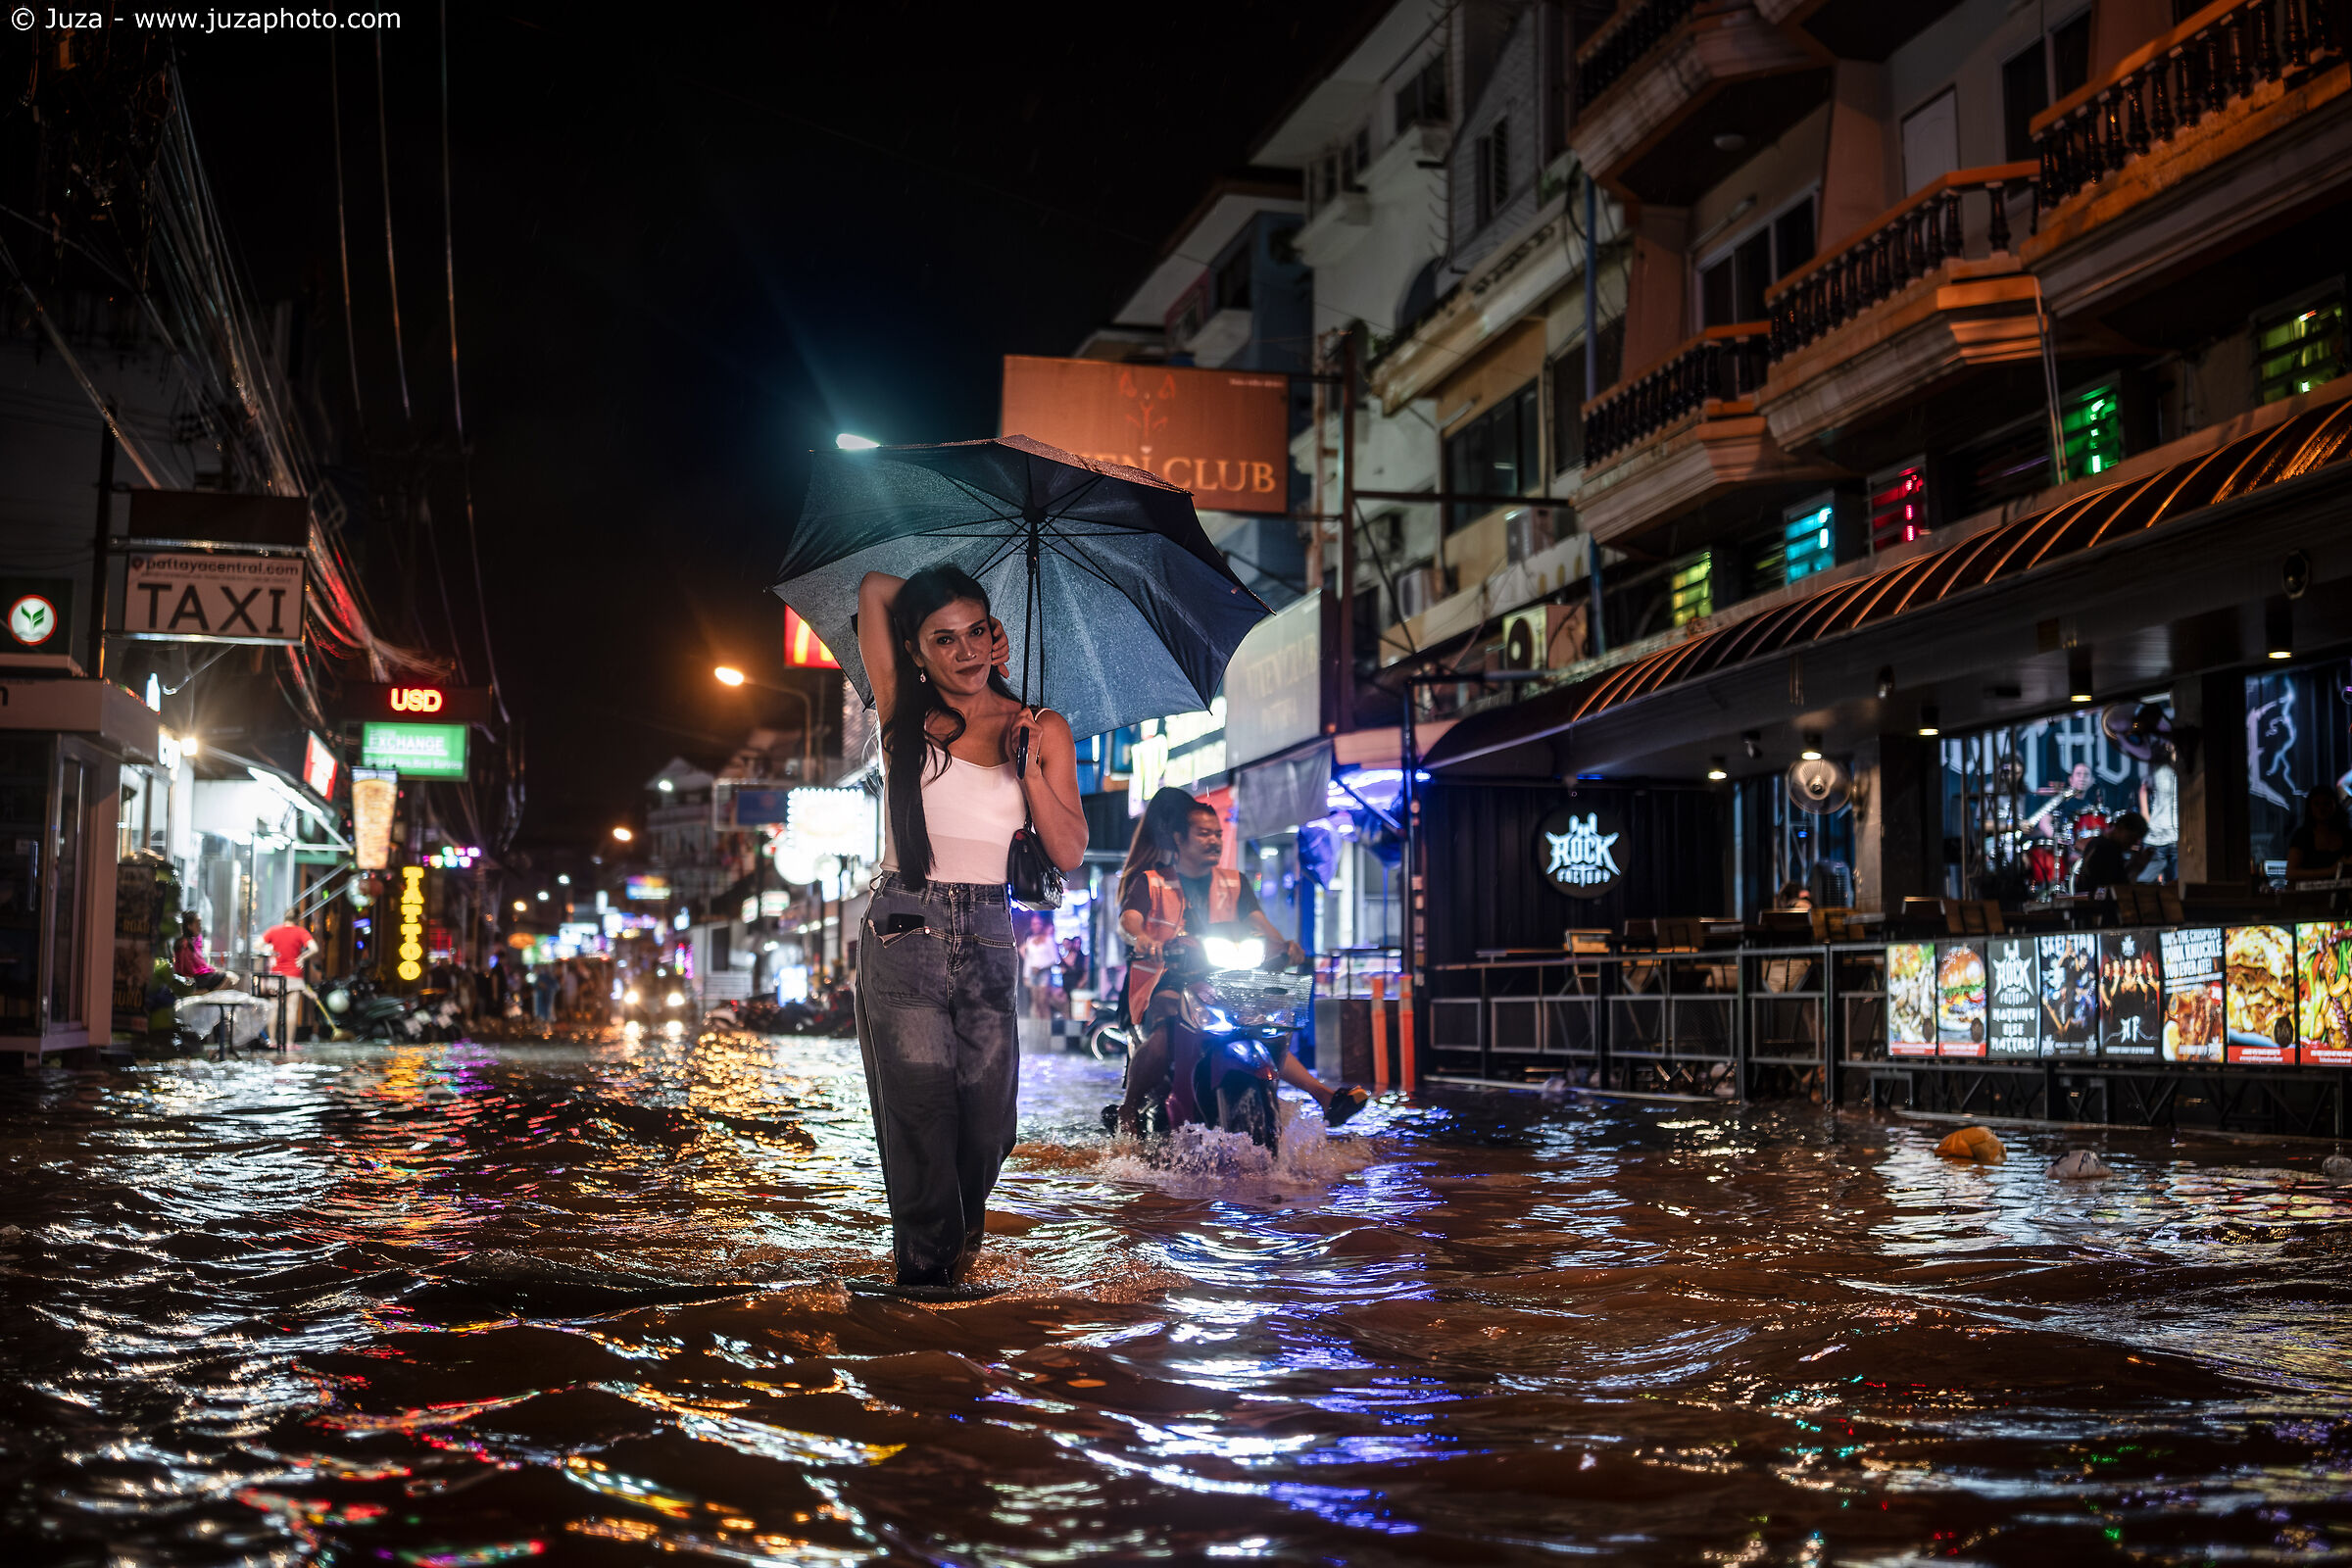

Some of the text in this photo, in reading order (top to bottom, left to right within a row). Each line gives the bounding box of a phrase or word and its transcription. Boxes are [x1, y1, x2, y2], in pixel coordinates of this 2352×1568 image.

[1163, 456, 1276, 494] CLUB
[146, 558, 299, 576] pattayacentral.com
[137, 582, 286, 634] TAXI
[390, 688, 443, 712] USD
[368, 734, 445, 751] EXCHANGE
[1544, 830, 1622, 876] ROCK
[398, 866, 424, 980] TATTOO
[2184, 939, 2223, 960] KNUCKLE
[1992, 956, 2034, 997] ROCK
[2164, 960, 2179, 979] YOU
[2179, 959, 2197, 977] EVER
[2002, 1022, 2025, 1038] ELSE
[1990, 1037, 2035, 1054] MATTERS
